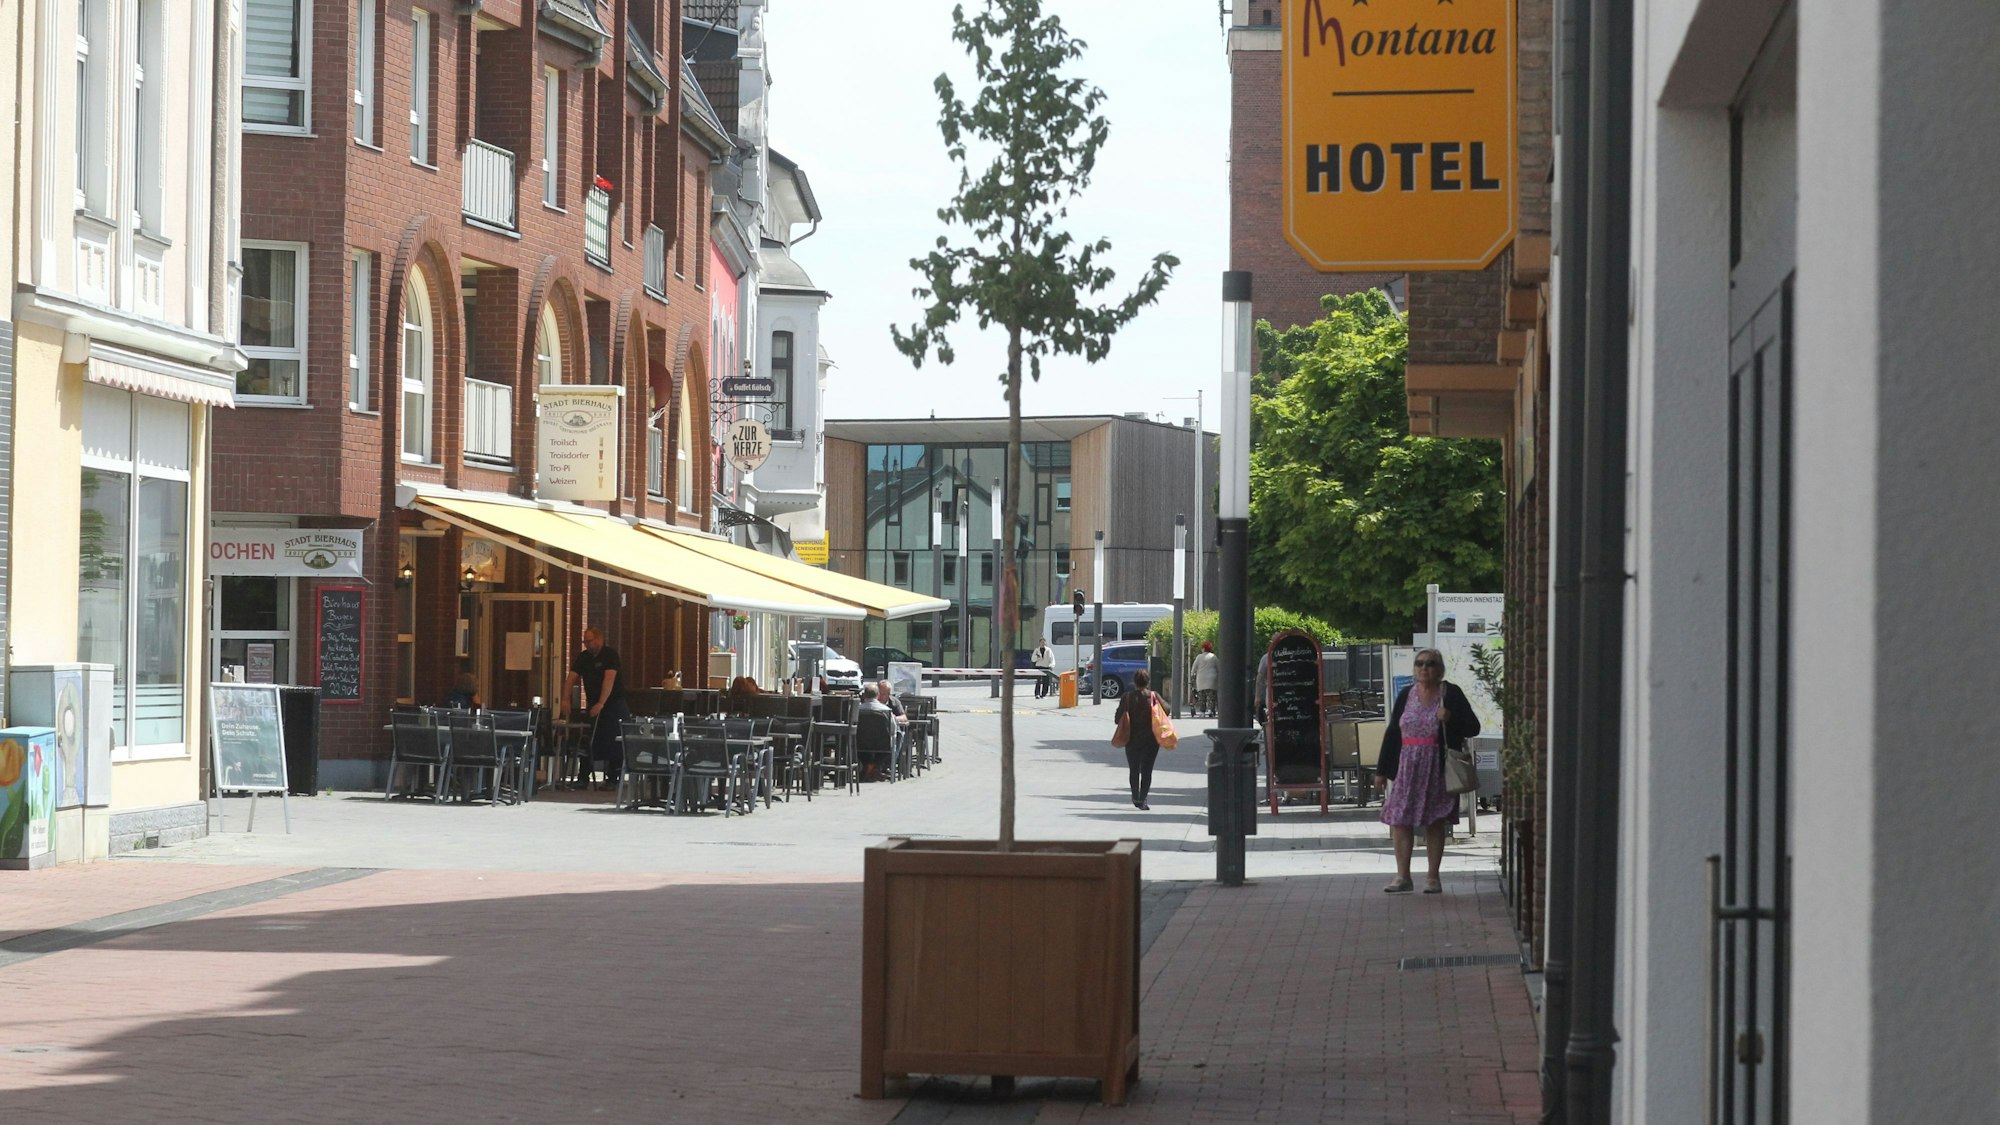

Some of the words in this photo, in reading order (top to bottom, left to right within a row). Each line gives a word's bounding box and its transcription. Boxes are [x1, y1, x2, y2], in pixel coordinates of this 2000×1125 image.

[1303, 0, 1496, 66] Montana
[1305, 141, 1501, 194] HOTEL
[543, 399, 569, 411] STADT
[572, 398, 612, 412] BIERHAUS
[738, 425, 757, 441] ZUR
[549, 438, 578, 446] Troilsch
[733, 441, 763, 457] KERZE
[549, 451, 590, 459] Troisdorfer
[549, 464, 571, 472] Tro-Pi
[549, 477, 577, 485] Weizen
[284, 535, 312, 549] STADT
[314, 534, 358, 549] BIERHAUS
[323, 595, 360, 609] Bierhaus
[327, 609, 354, 623] Burger
[221, 722, 235, 730] Dein
[222, 729, 236, 737] Dein
